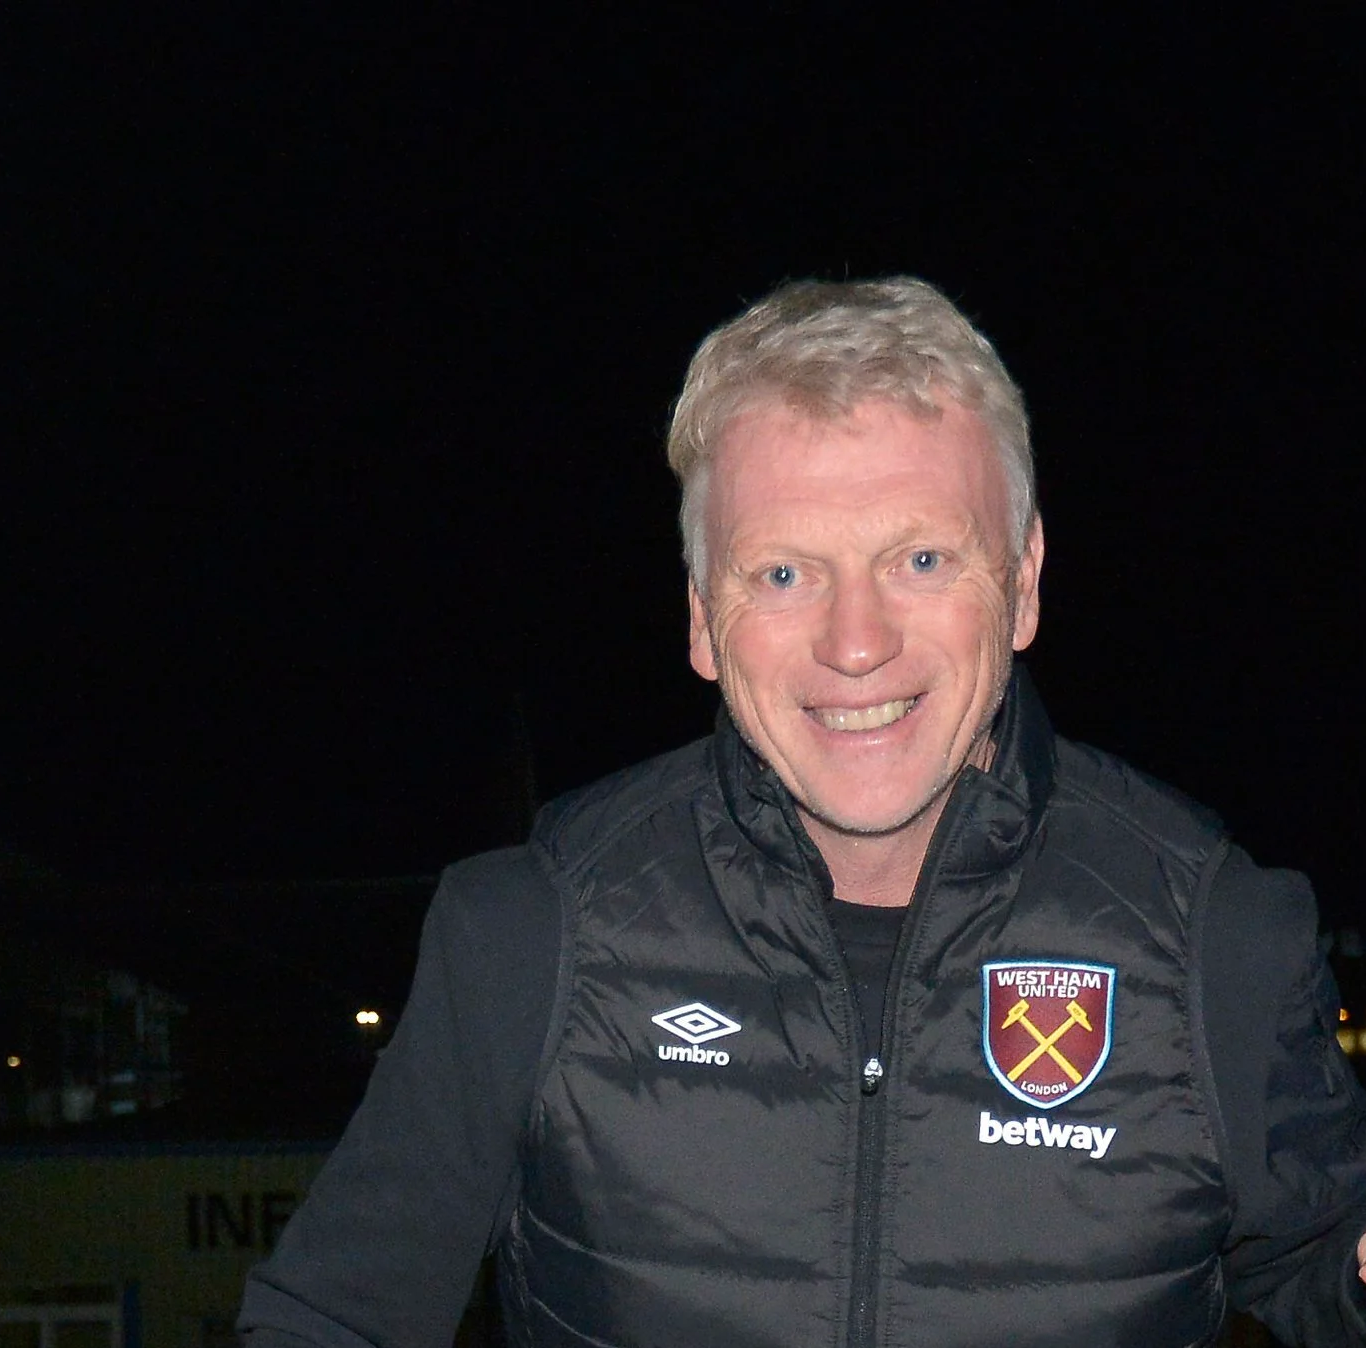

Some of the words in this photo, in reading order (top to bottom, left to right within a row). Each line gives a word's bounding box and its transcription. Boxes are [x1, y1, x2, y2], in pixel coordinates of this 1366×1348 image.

[997, 971, 1050, 986] WEST
[1054, 971, 1101, 989] HAM
[1018, 985, 1078, 998] UNITED
[658, 1044, 730, 1067] umbro
[1021, 1080, 1068, 1096] LONDON
[979, 1111, 1117, 1159] betway
